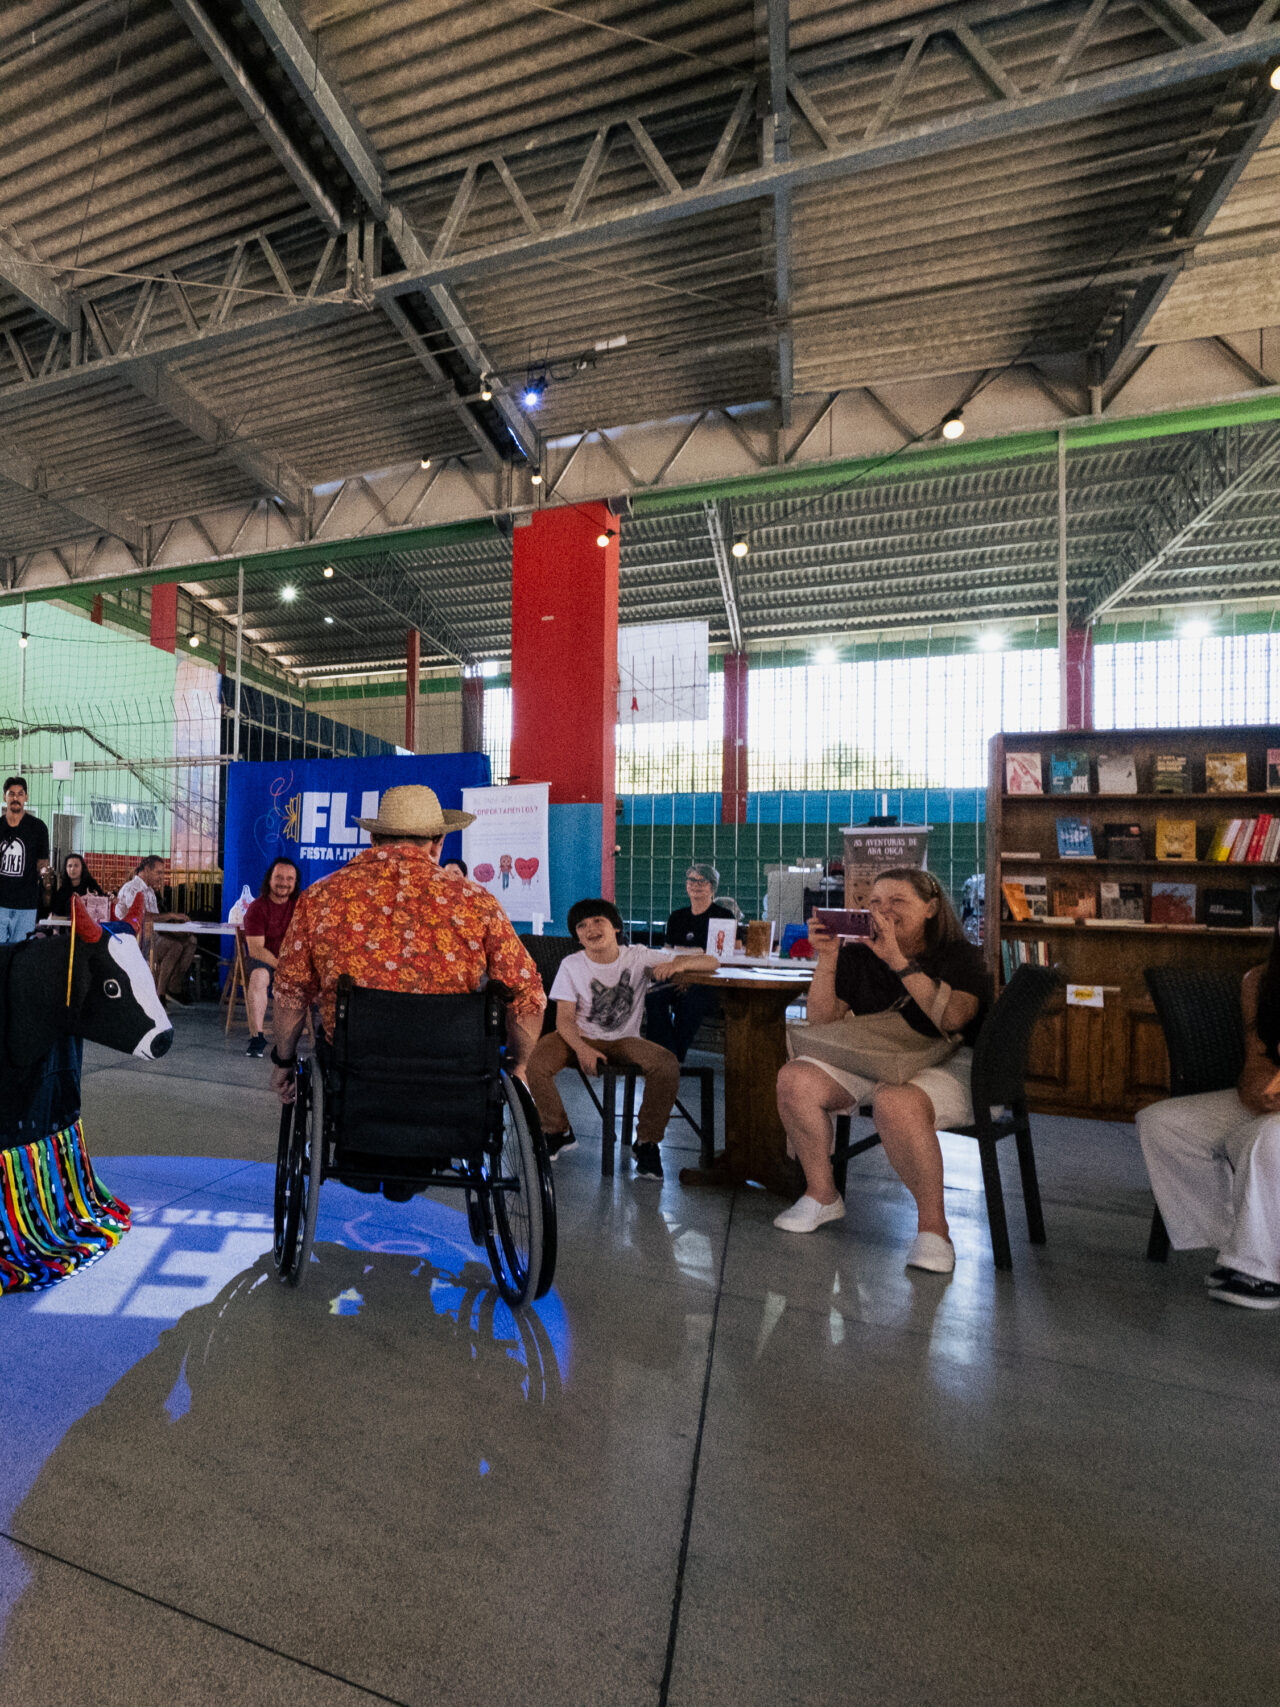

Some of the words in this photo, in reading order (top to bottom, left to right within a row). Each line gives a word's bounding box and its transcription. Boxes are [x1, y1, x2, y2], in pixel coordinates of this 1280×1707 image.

[853, 839, 863, 847] AS
[865, 838, 905, 846] AVENTURAS
[299, 846, 334, 860] FESTA
